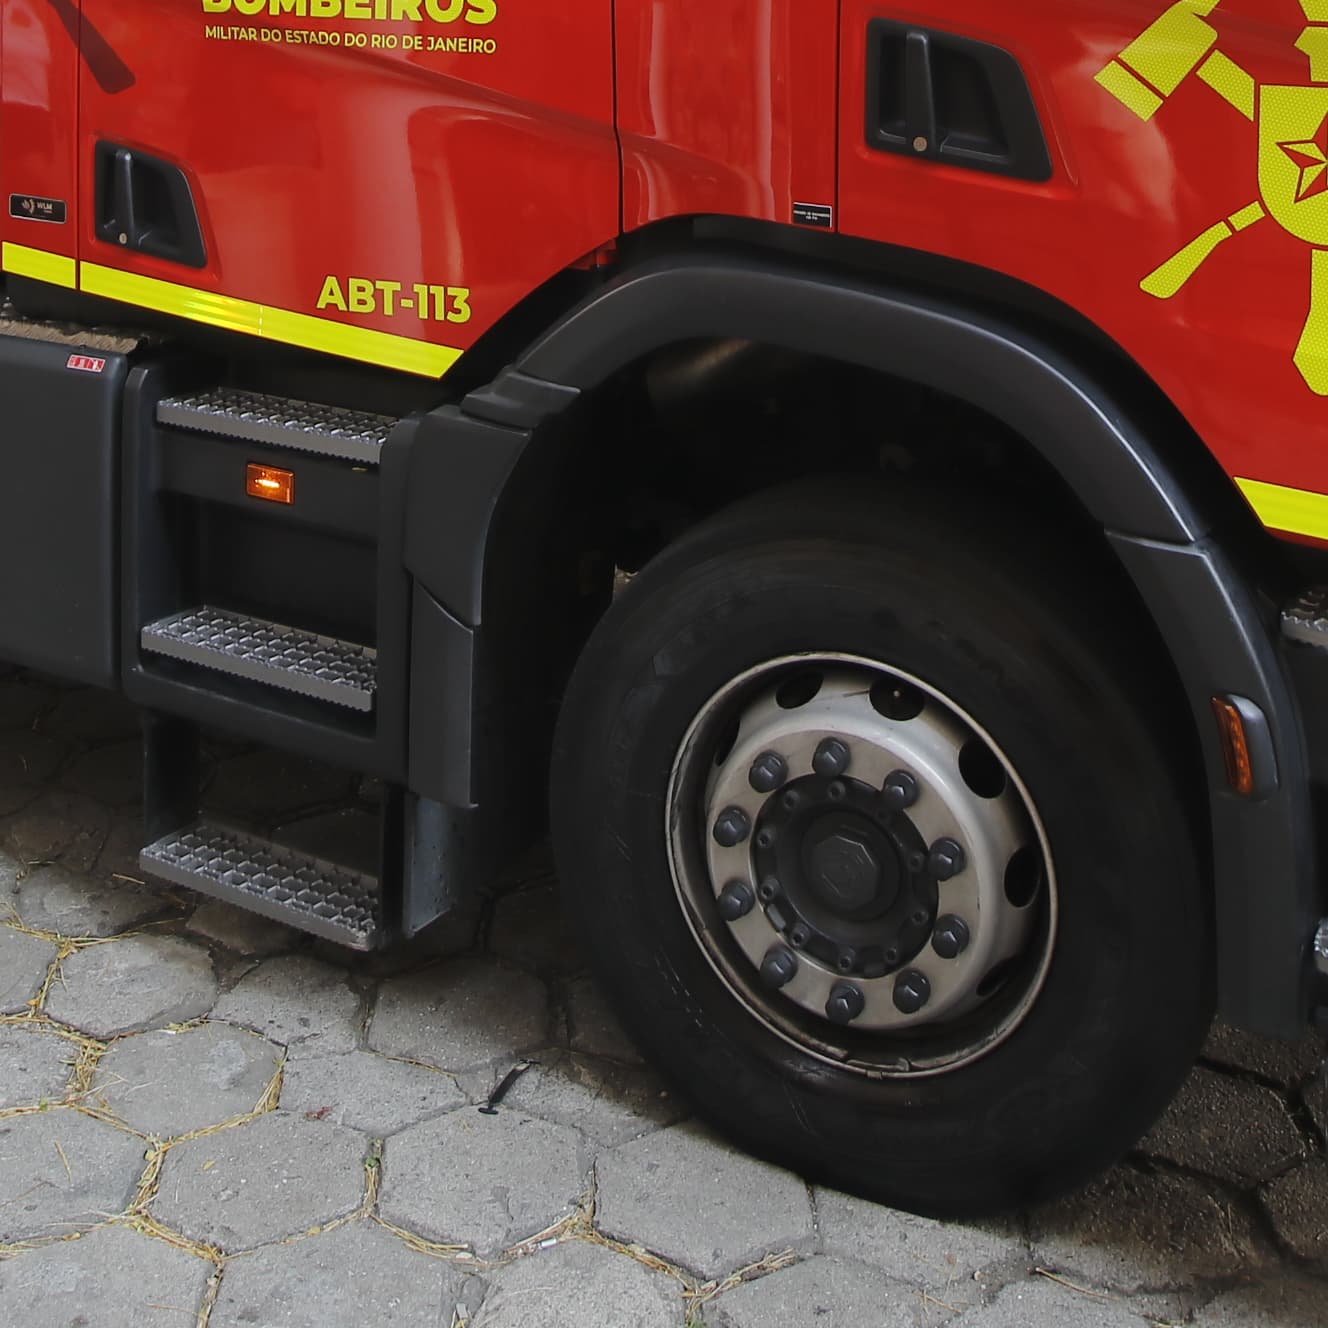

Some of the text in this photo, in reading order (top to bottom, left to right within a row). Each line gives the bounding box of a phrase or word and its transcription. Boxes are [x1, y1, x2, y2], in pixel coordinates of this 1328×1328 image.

[205, 25, 497, 55] MILITAR DO ESTADO DO RIO DE JANEIRO
[316, 275, 471, 324] ABT-113
